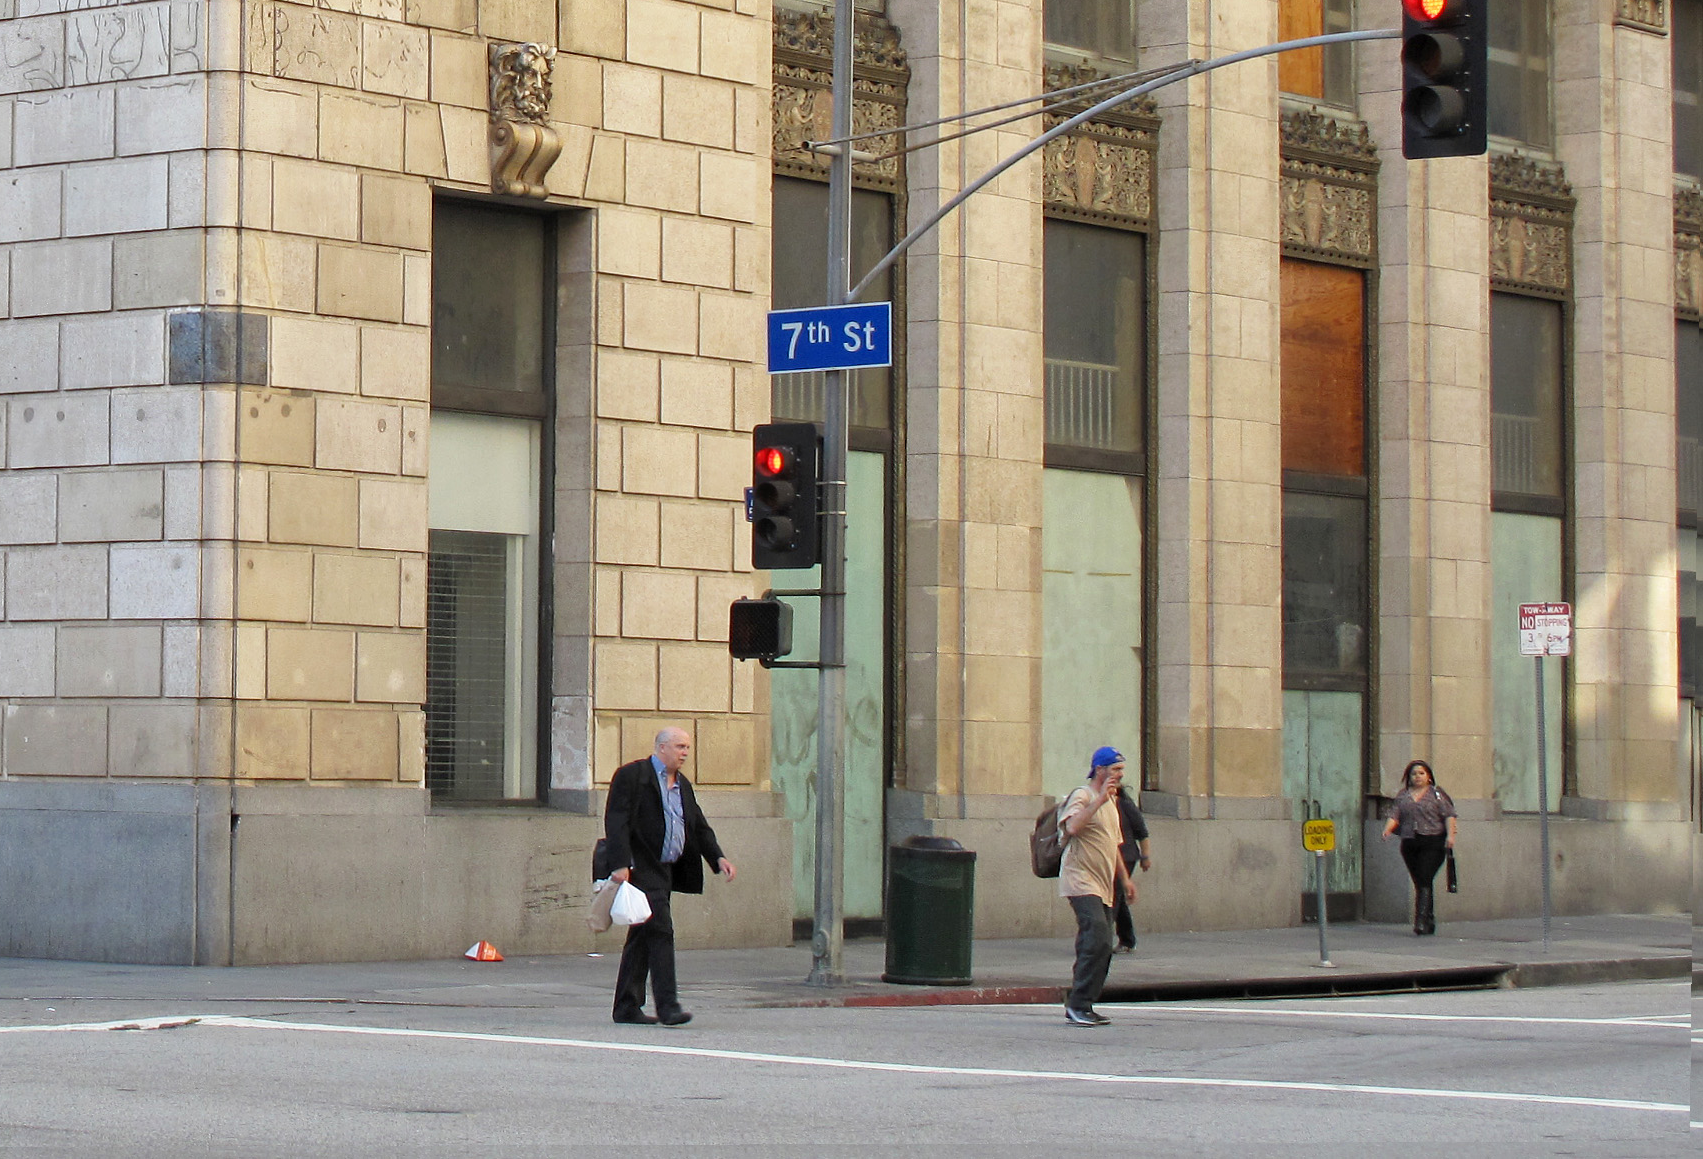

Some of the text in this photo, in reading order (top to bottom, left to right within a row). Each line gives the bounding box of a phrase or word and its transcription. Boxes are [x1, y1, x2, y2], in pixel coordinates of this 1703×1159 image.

[781, 321, 875, 359] 7th St
[1521, 616, 1567, 629] NO STOPPING
